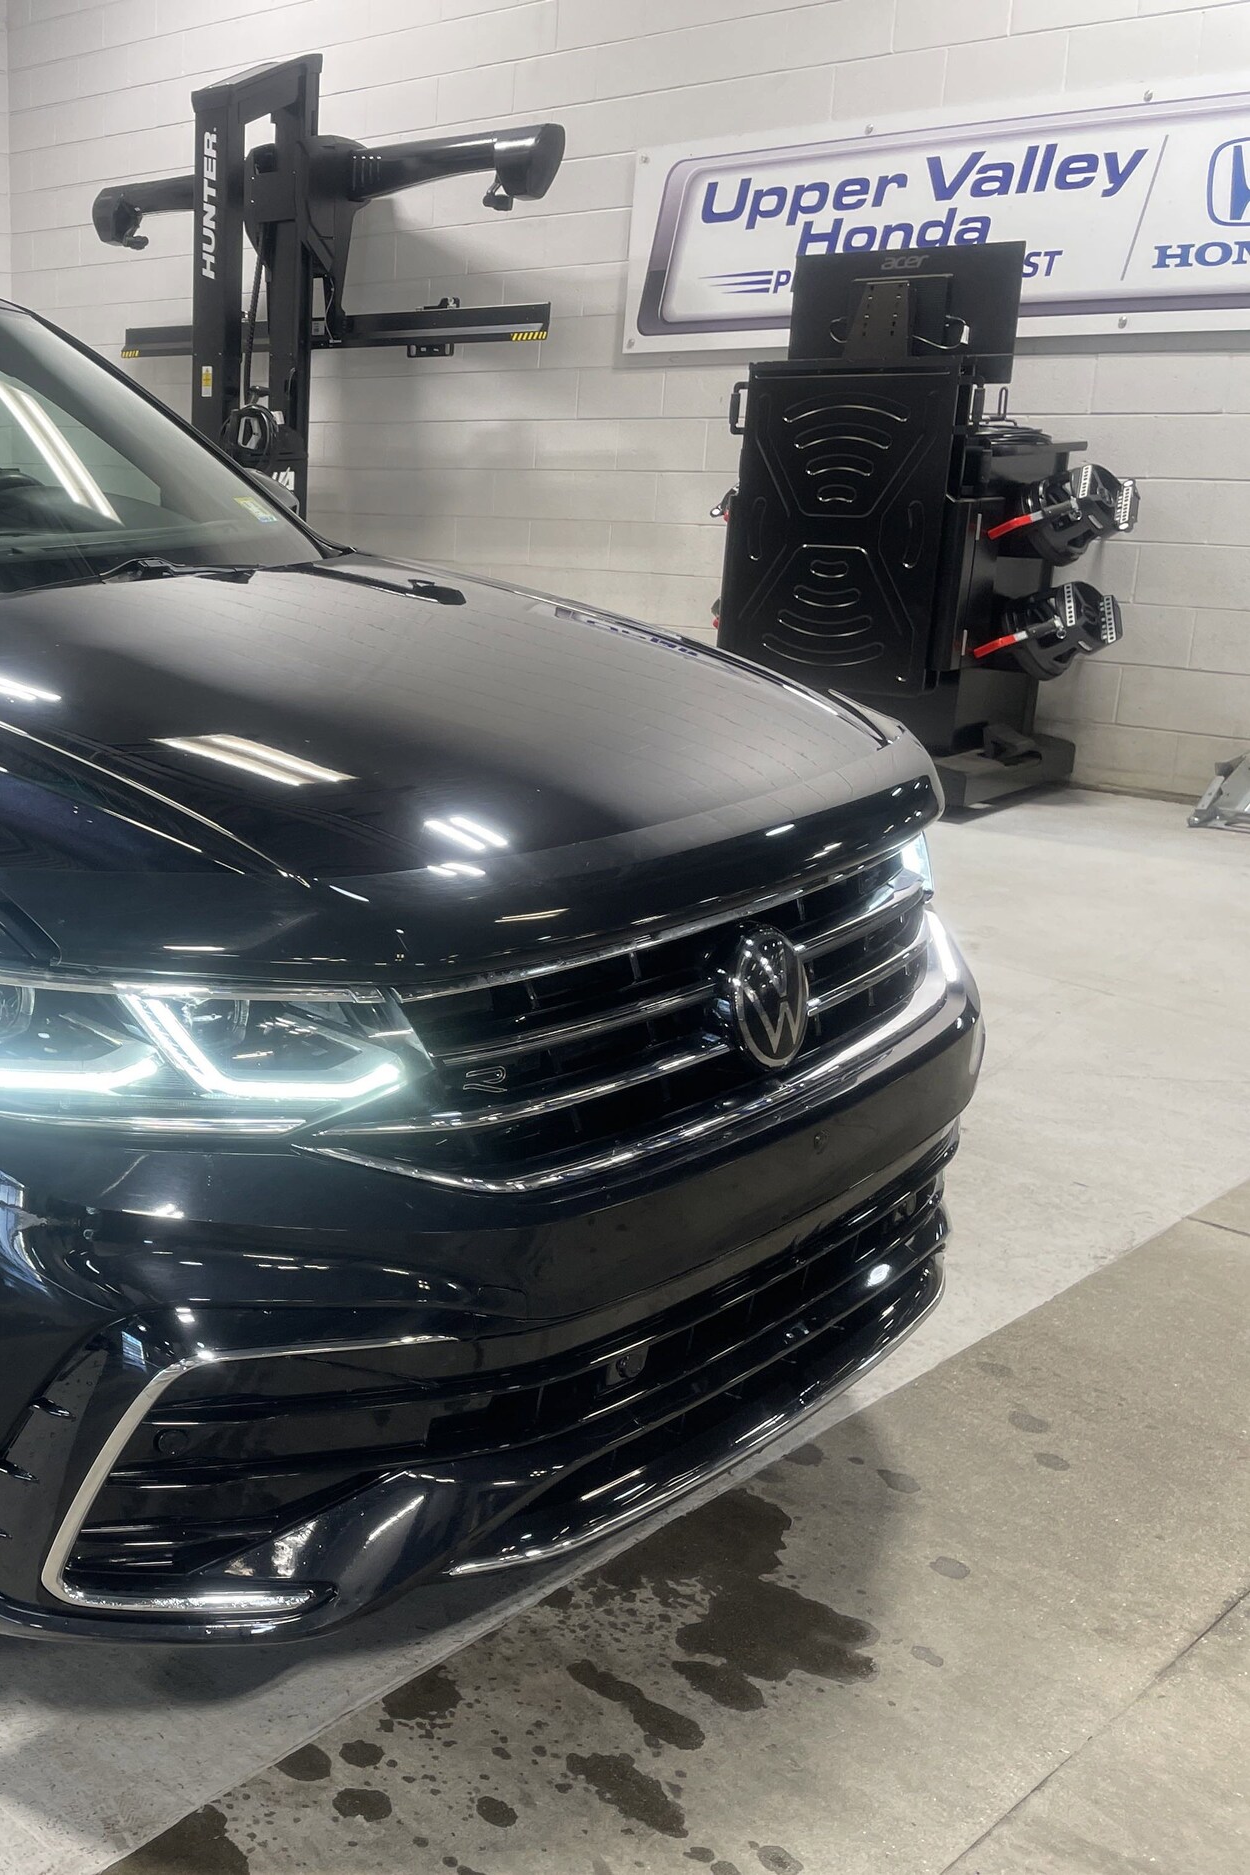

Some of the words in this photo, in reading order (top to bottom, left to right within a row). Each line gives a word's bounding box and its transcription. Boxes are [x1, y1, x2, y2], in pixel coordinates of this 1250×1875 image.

[202, 131, 217, 280] HUNTER
[701, 169, 908, 230] Upper
[926, 143, 1150, 198] Valley
[798, 207, 992, 256] Honda
[881, 253, 929, 270] acer
[1022, 250, 1063, 278] ST
